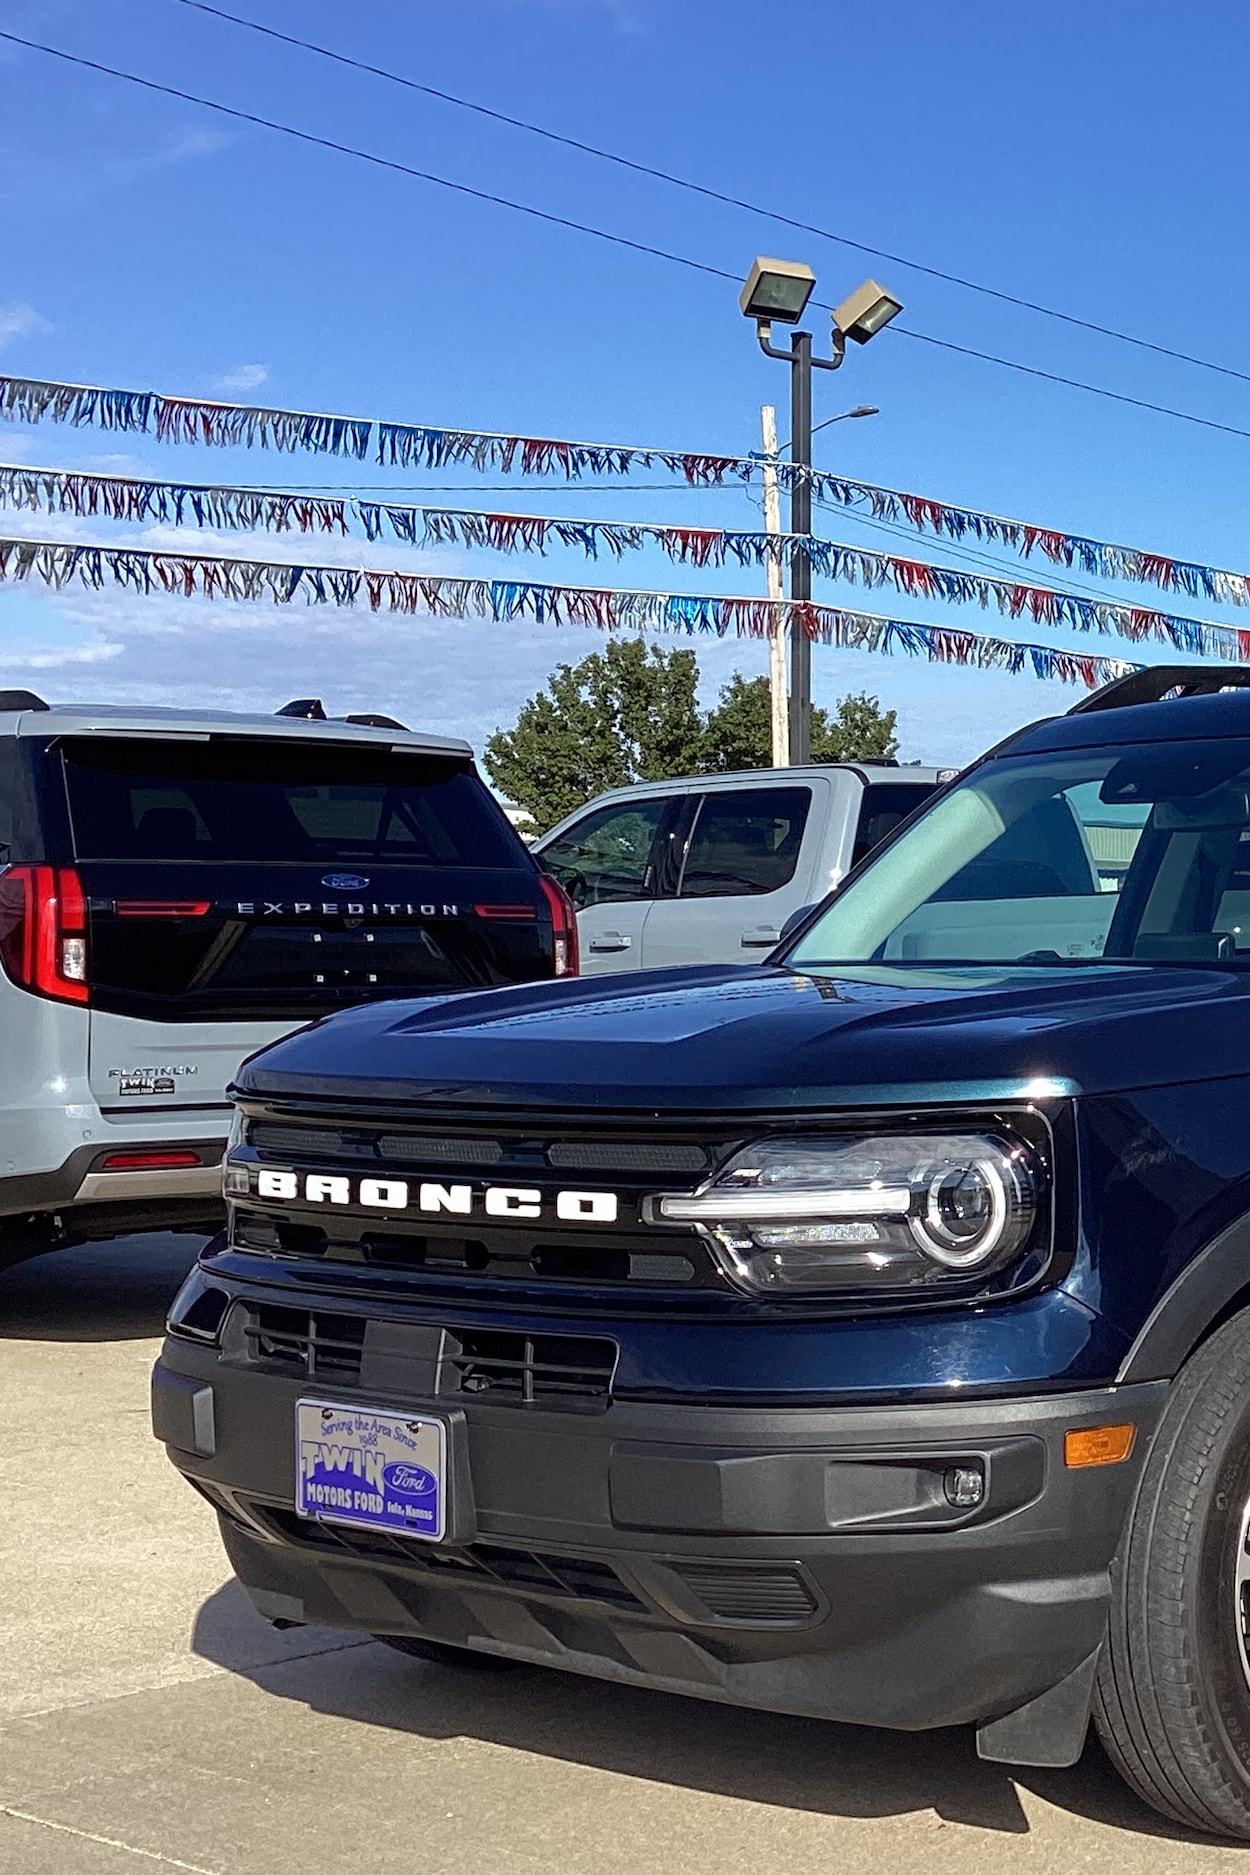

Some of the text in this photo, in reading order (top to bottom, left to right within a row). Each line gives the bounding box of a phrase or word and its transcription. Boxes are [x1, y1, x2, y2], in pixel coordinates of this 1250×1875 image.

[331, 876, 359, 888] Ford
[237, 902, 458, 916] EXPEDITION
[108, 1066, 198, 1078] PLATINUM
[257, 1169, 618, 1222] BRONCO
[320, 1414, 418, 1451] Serving the Area Since
[301, 1440, 385, 1498] TWIN
[392, 1466, 426, 1491] Ford
[306, 1482, 385, 1514] MOTORS FORD
[405, 1504, 433, 1521] Kansas
